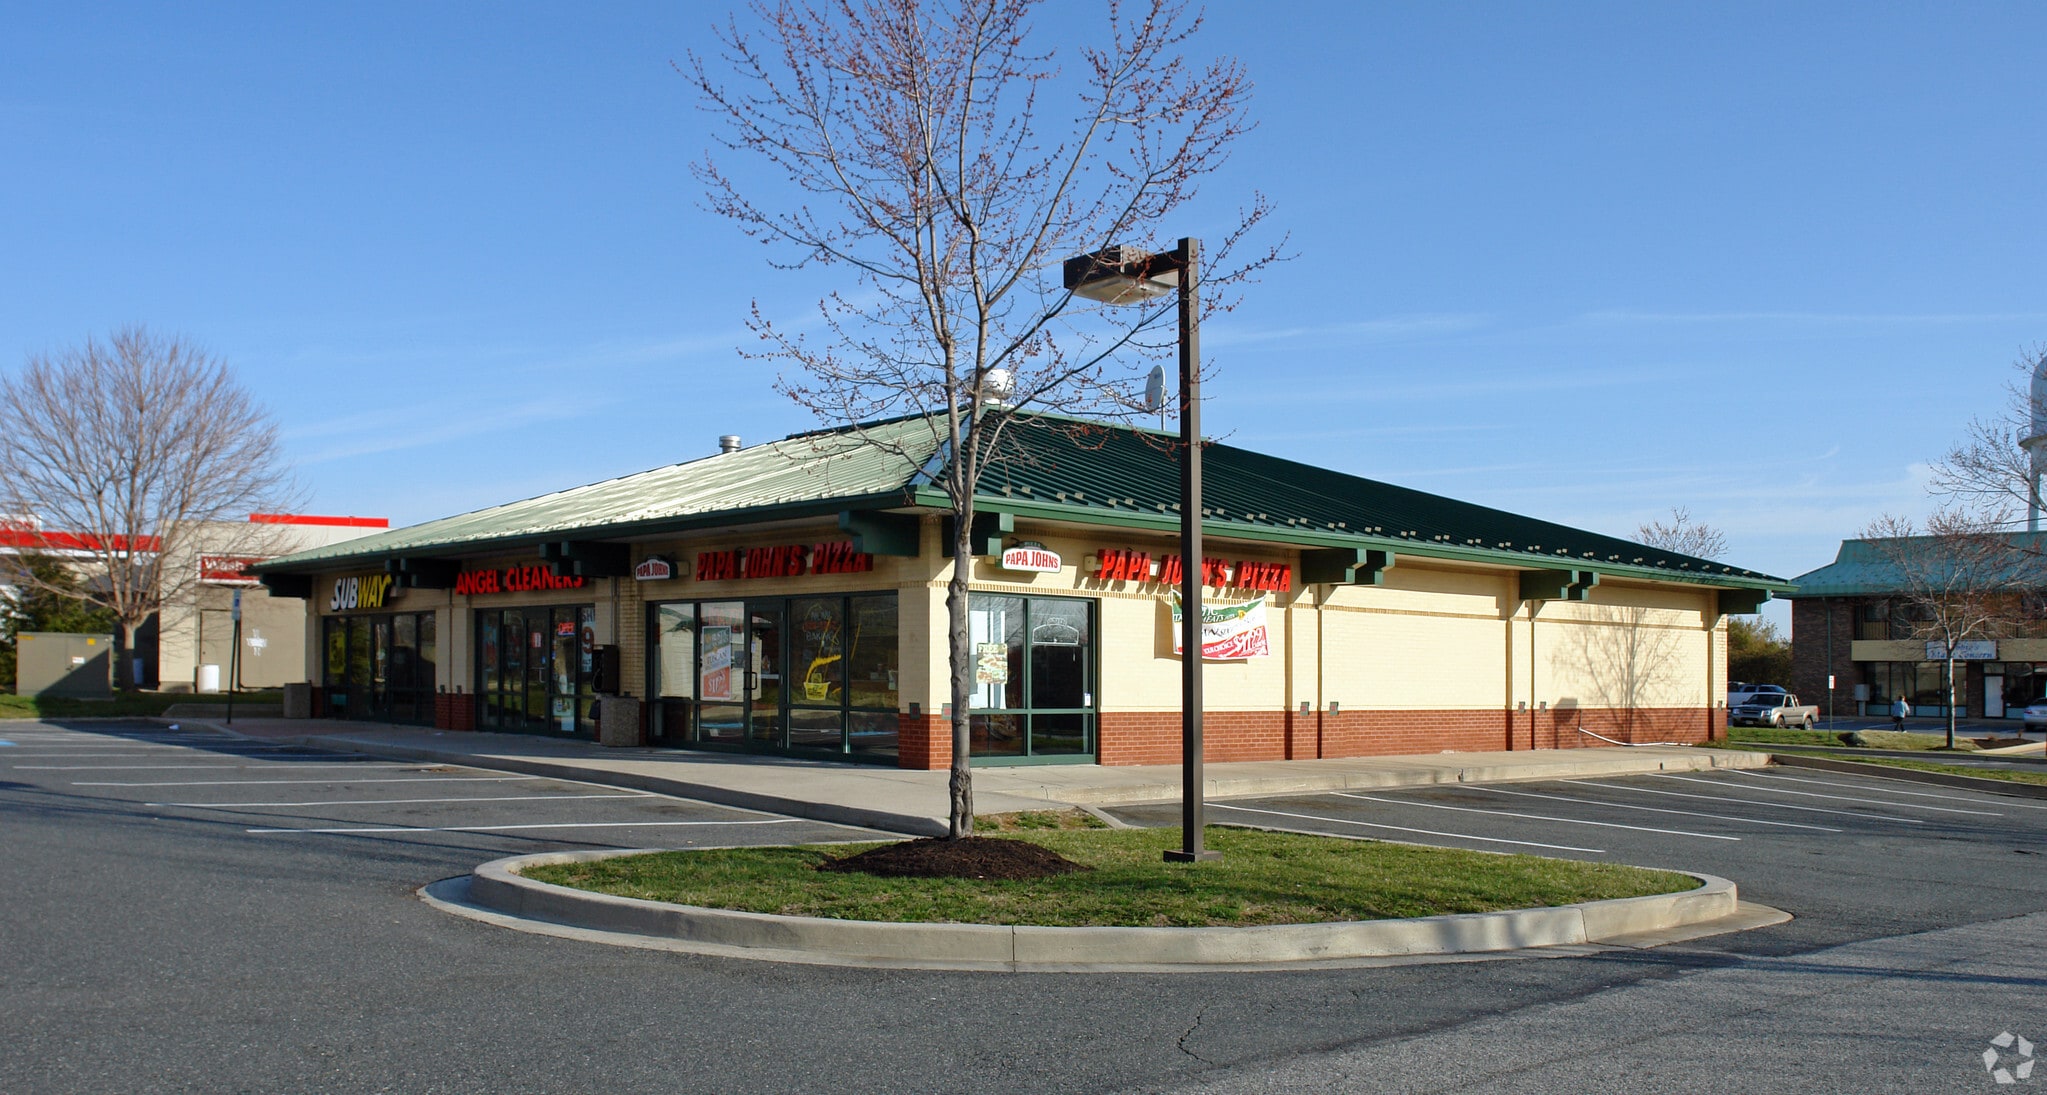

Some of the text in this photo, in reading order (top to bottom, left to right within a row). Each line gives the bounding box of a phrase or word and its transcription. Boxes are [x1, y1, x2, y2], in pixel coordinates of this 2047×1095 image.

[696, 552, 740, 581] PAPA
[1005, 551, 1028, 566] PAPA
[1099, 550, 1151, 583] PAPA
[1238, 560, 1291, 593] PIZZA
[330, 573, 392, 610] SUBWAY
[456, 569, 500, 595] ANGEL
